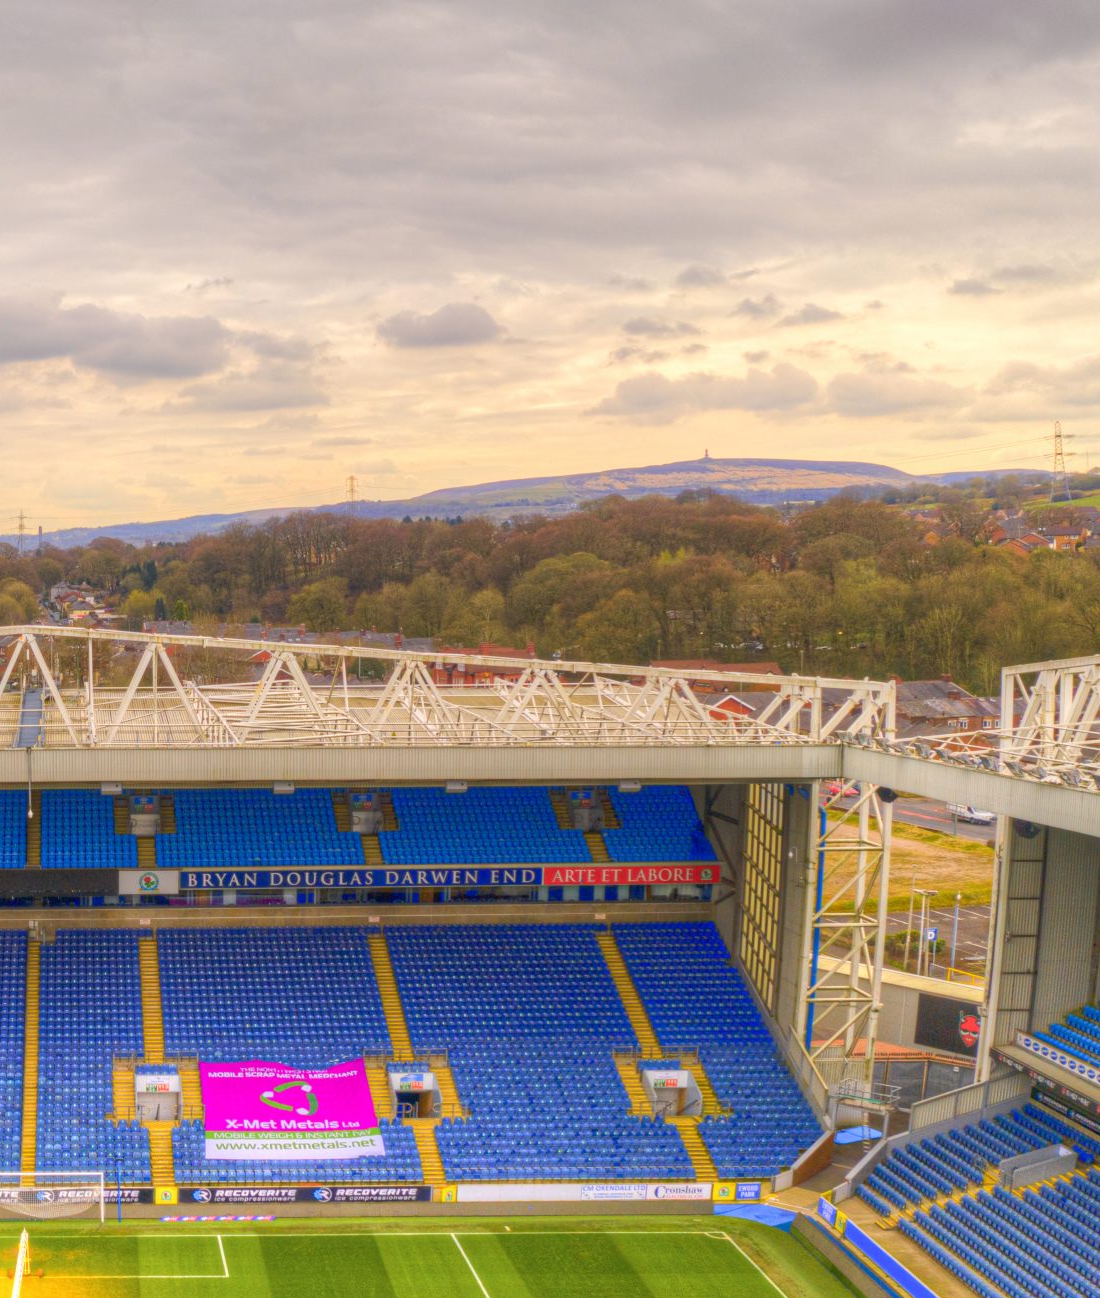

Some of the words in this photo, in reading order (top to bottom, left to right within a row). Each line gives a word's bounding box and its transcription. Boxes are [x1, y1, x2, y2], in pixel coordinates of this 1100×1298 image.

[188, 873, 258, 887] BRYAN
[270, 872, 374, 886] DOUGLAS
[385, 870, 479, 885] DARWEN
[490, 870, 536, 883] END
[552, 870, 596, 883] ARTE
[602, 869, 622, 882] ET
[627, 868, 694, 882] LABORE
[928, 932, 935, 940] D
[225, 1119, 277, 1129] X-Met
[281, 1119, 339, 1129] Metals
[216, 1138, 376, 1150] www.xmetmetals.net
[336, 1188, 417, 1196] RECOVERITE
[654, 1186, 702, 1198] Cronshaw
